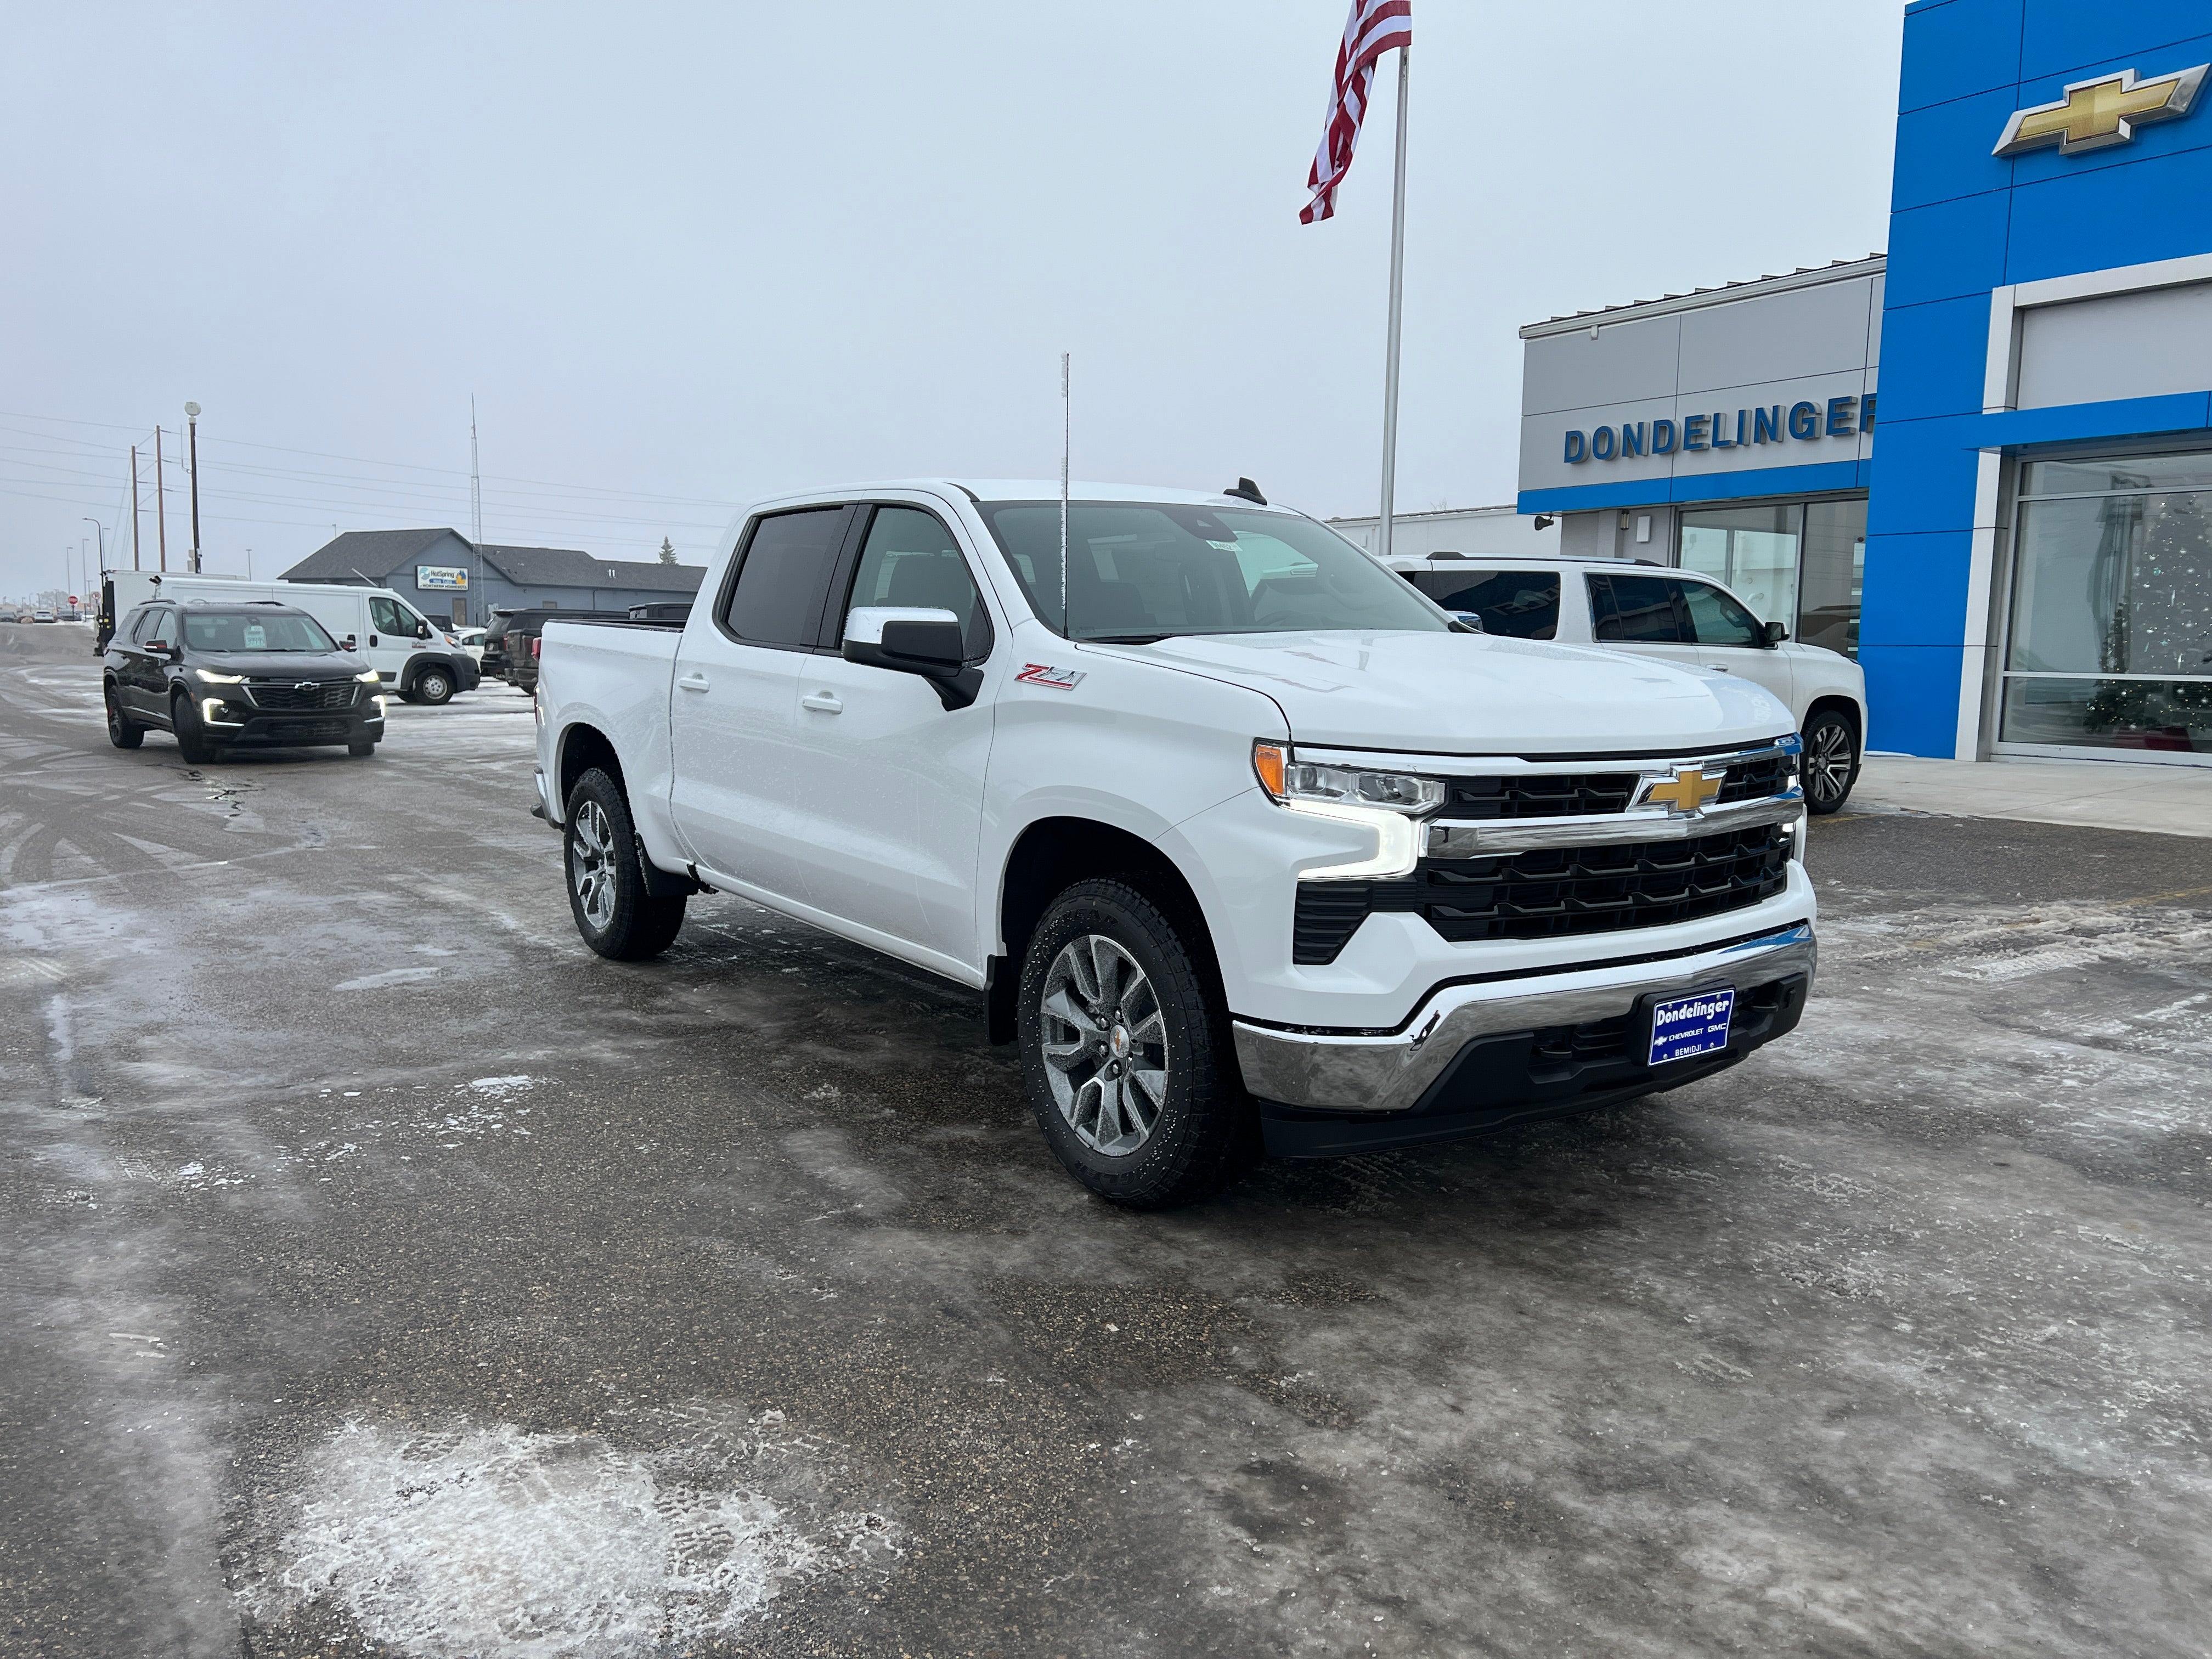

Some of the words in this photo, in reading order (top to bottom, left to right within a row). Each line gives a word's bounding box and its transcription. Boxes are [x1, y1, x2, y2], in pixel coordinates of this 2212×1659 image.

[1014, 662, 1087, 691] Z71
[1656, 1000, 1729, 1026] Dondelinger
[1669, 1028, 1704, 1041] CHEVROLET
[1707, 1023, 1727, 1032] GMC
[1675, 1044, 1702, 1057] BEMIDJI
